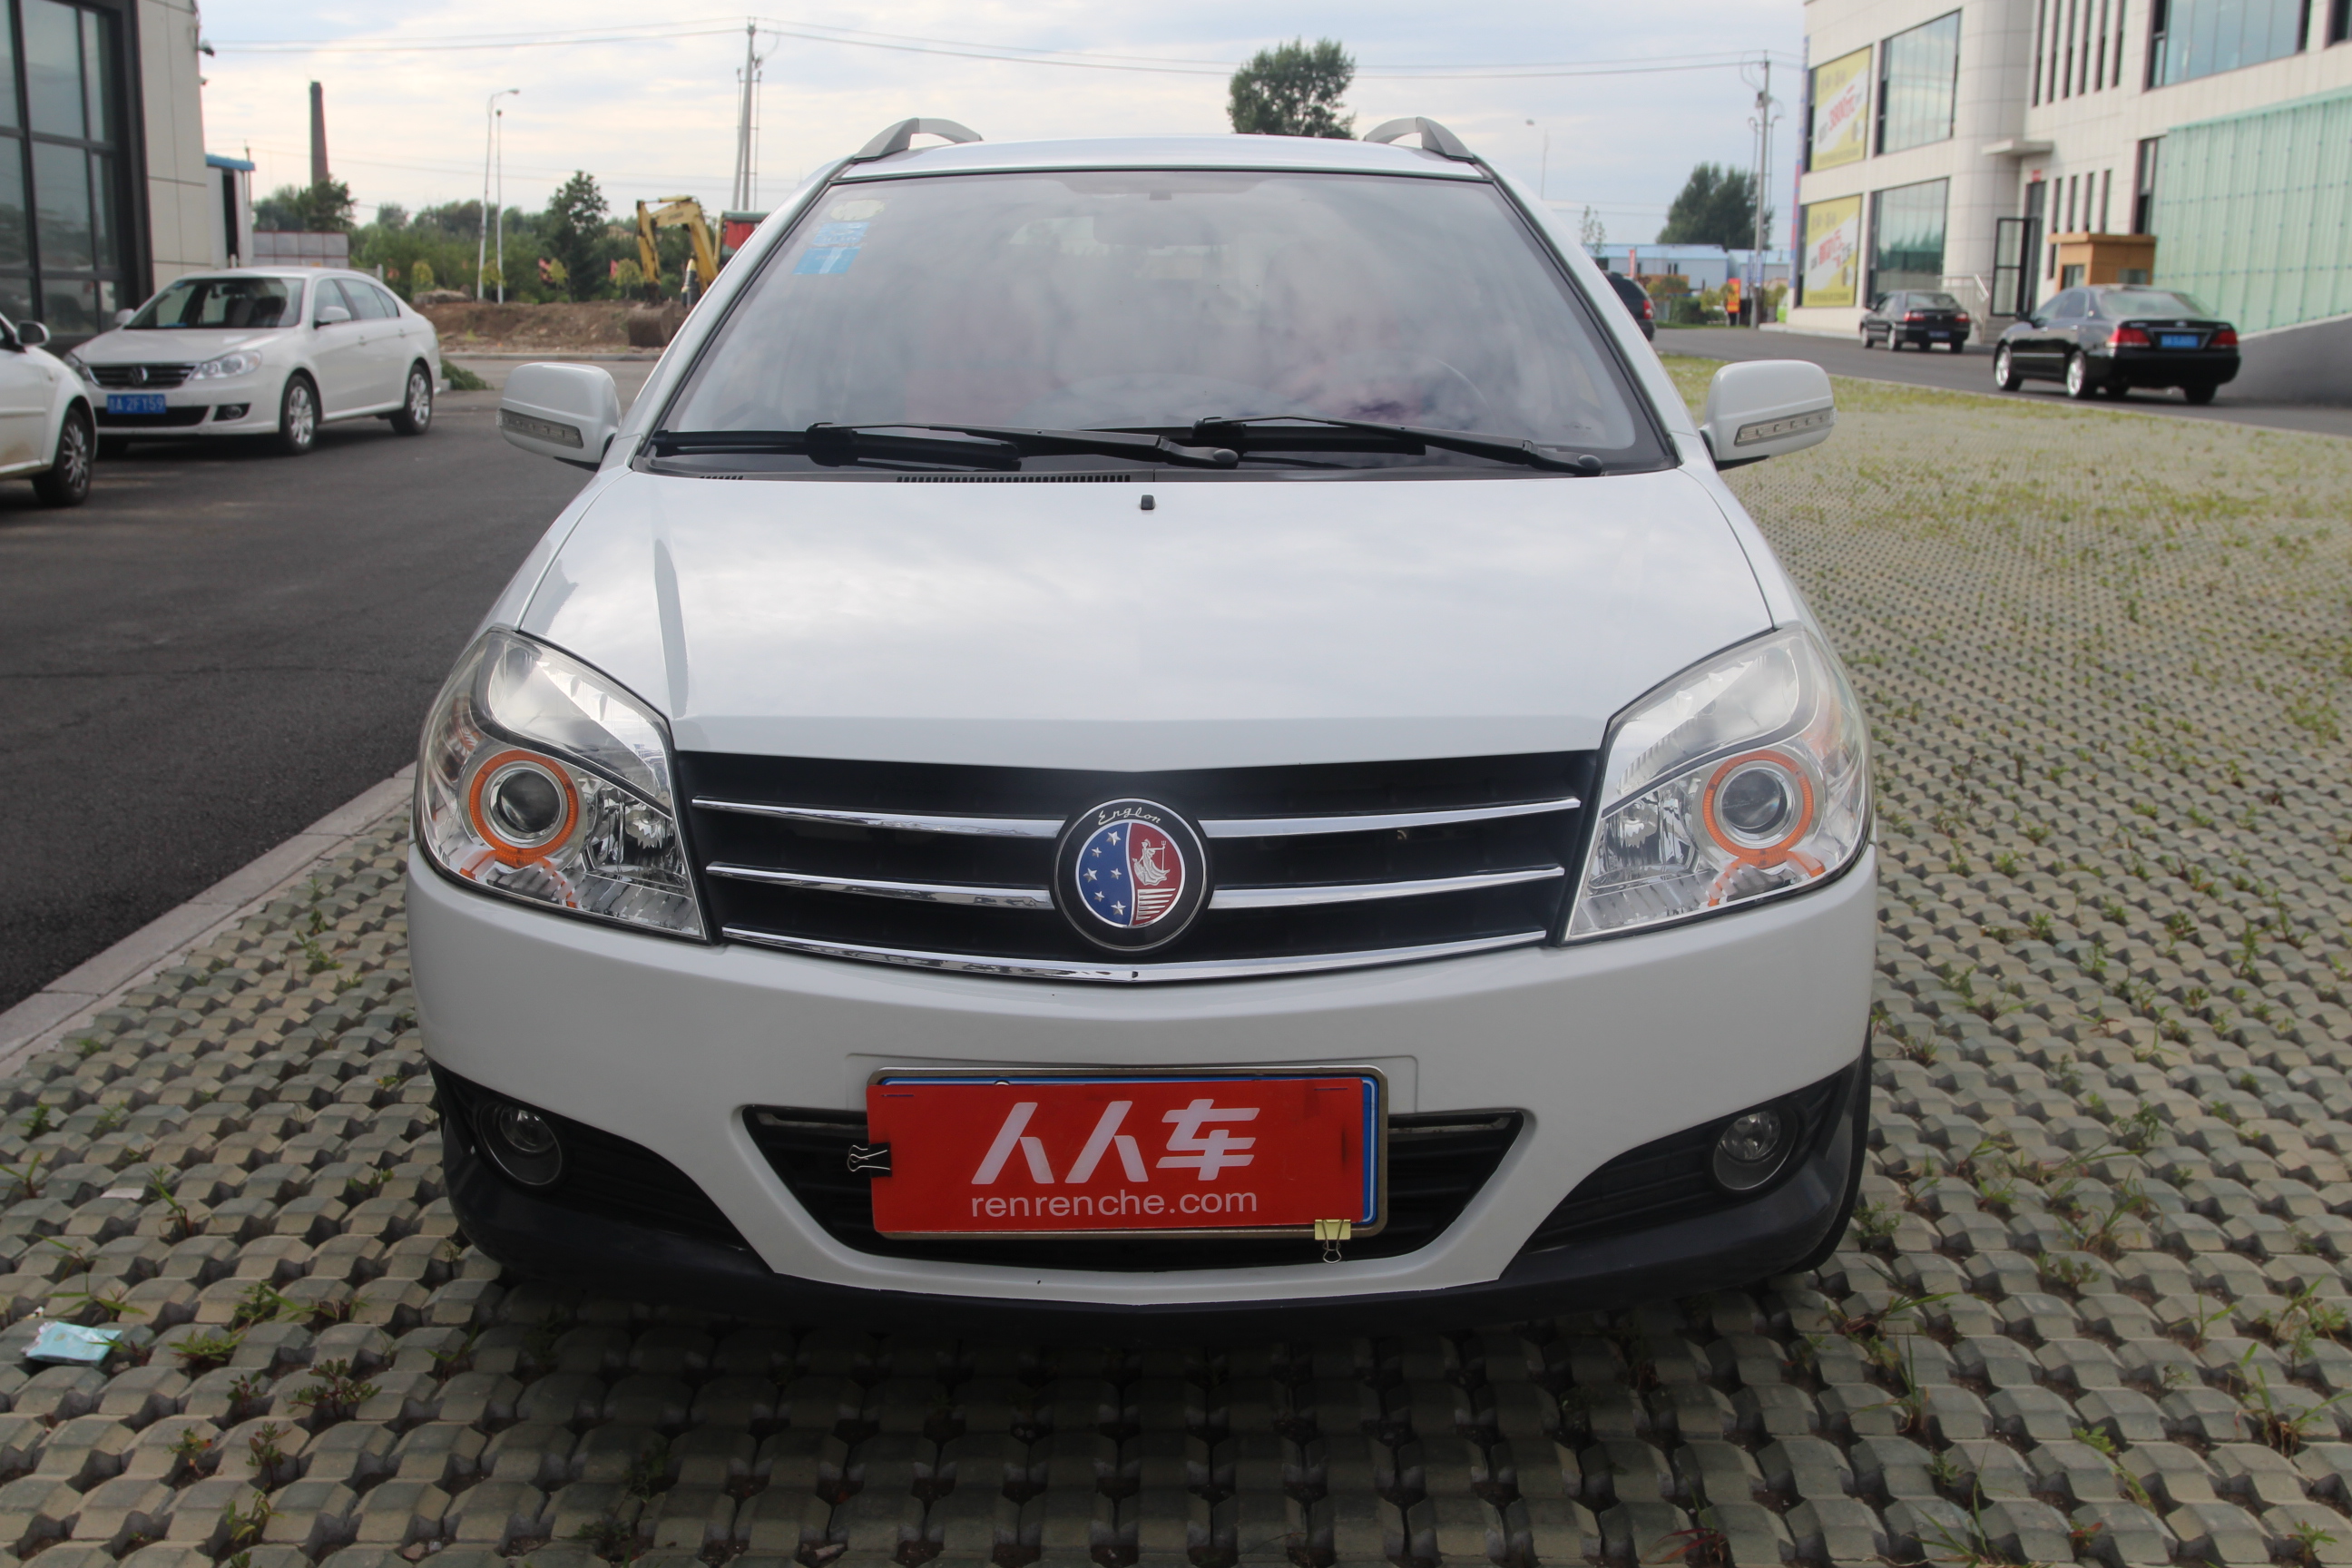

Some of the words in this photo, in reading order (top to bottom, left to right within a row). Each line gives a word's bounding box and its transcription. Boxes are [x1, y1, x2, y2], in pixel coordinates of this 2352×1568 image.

[1097, 807, 1161, 826] Englon
[971, 1098, 1260, 1184] 人人车
[971, 1189, 1258, 1218] renrenche.com
